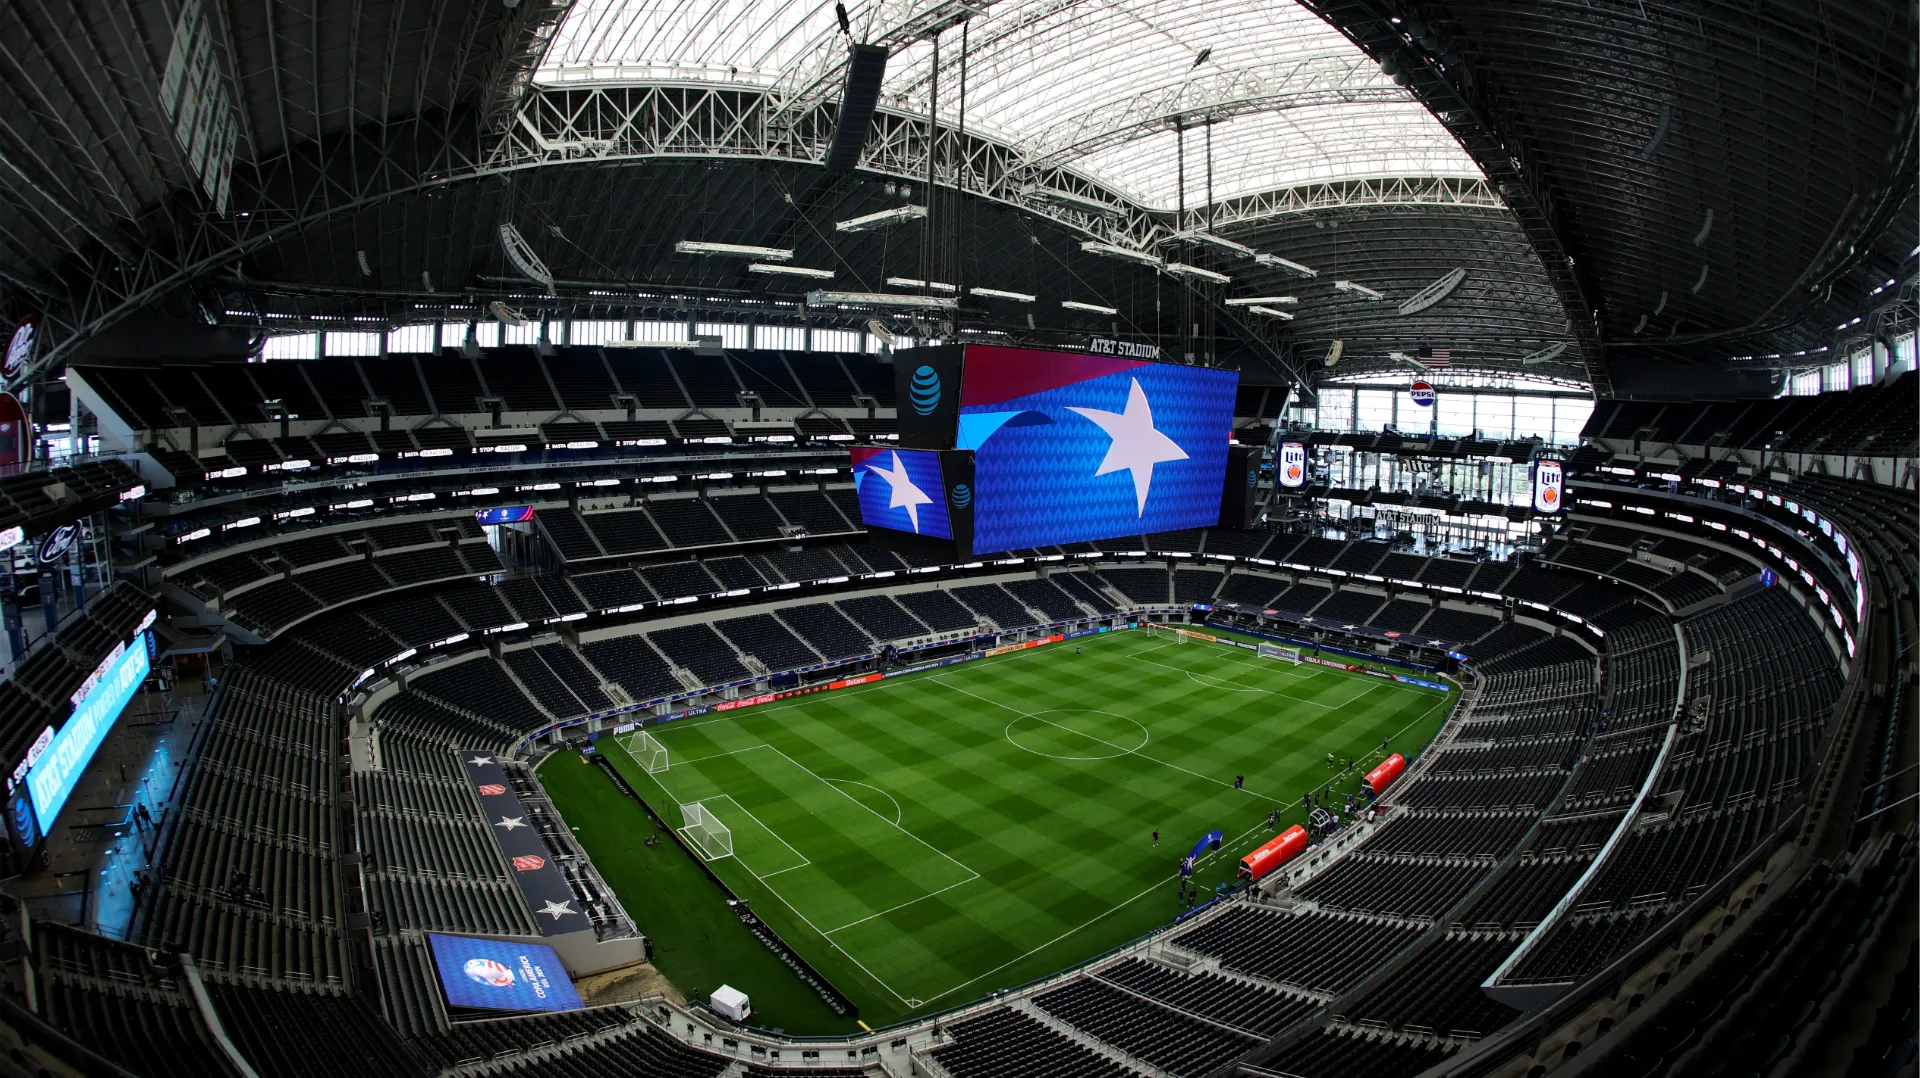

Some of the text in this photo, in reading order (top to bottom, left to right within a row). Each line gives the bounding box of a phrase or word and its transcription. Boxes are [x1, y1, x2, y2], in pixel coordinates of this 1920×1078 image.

[1089, 338, 1160, 359] AT&T STADIUM
[333, 456, 348, 464] STOP
[1285, 450, 1304, 463] Lite
[1404, 459, 1433, 473] Lite
[210, 471, 222, 479] STOP
[1540, 471, 1561, 485] Lite
[277, 511, 290, 519] STOP
[1376, 511, 1440, 526] AT&T STADIUM
[46, 524, 77, 558] Ford
[1111, 623, 1128, 631] Degree
[845, 678, 866, 687] Betano
[737, 698, 755, 707] Coca-Cola
[756, 694, 774, 703] Coca-Cola
[688, 708, 707, 716] ULTRA
[717, 702, 735, 711] Coca-Cola
[613, 722, 635, 735] PUMA
[35, 753, 62, 815] AT&T
[57, 706, 96, 779] STADIUM
[14, 758, 28, 784] STOP
[519, 955, 546, 999] COPA AMERICA
